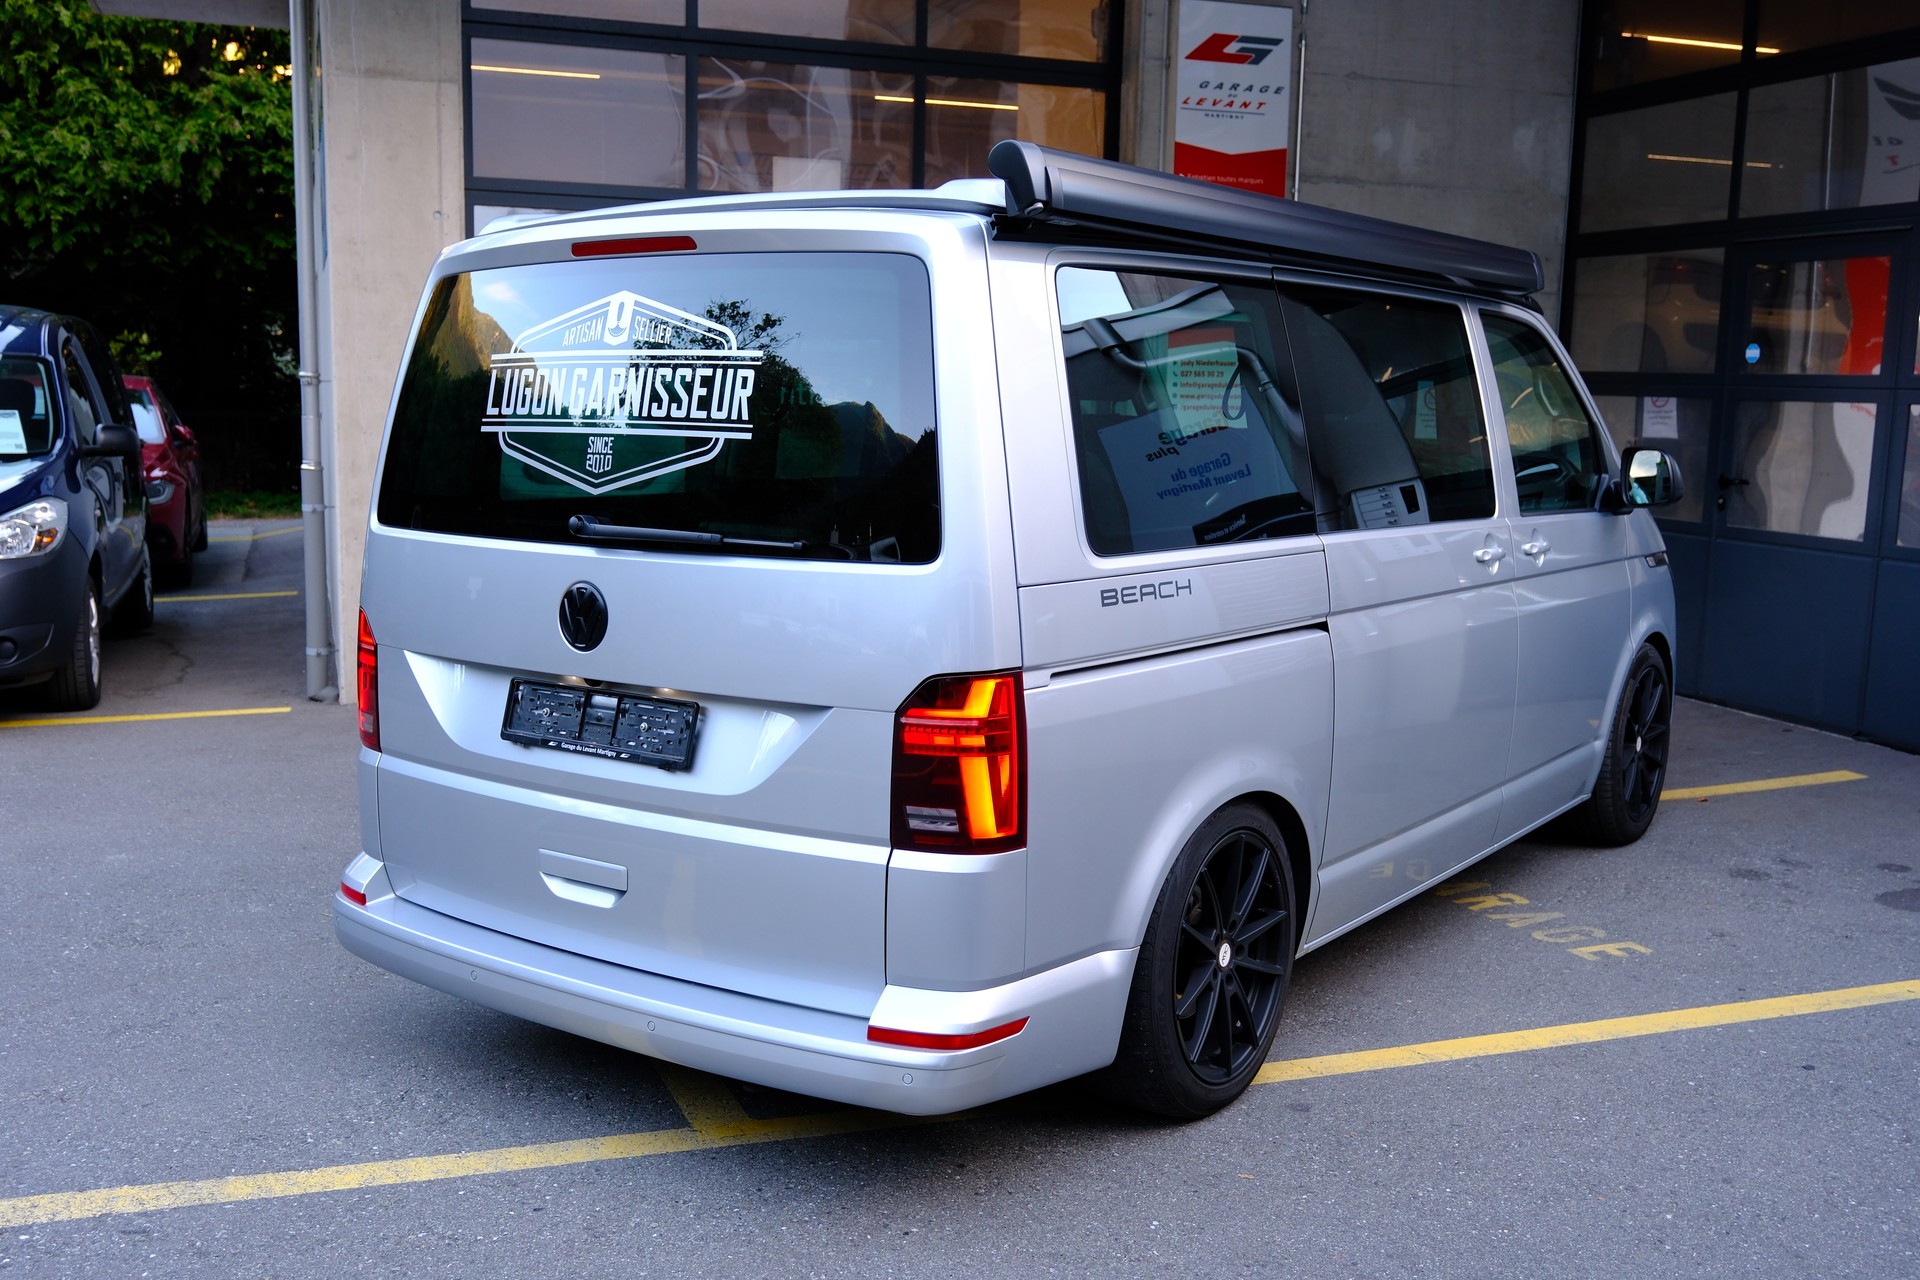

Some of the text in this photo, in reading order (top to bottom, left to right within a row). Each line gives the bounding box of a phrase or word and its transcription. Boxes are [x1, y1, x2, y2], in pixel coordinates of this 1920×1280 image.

[1198, 80, 1285, 95] GARAGE
[1181, 96, 1267, 110] LEVANT
[1217, 175, 1237, 183] toutes
[1238, 177, 1264, 185] marques
[562, 315, 672, 347] ARTISAN SELLIER
[486, 367, 567, 415] LUGON
[569, 367, 755, 421] GARNISSEUR
[587, 436, 615, 454] SINCE
[585, 454, 613, 474] 2010
[1100, 578, 1192, 608] BEACH
[560, 742, 576, 751] Garage
[582, 745, 597, 754] Levant
[597, 748, 617, 758] Martigny
